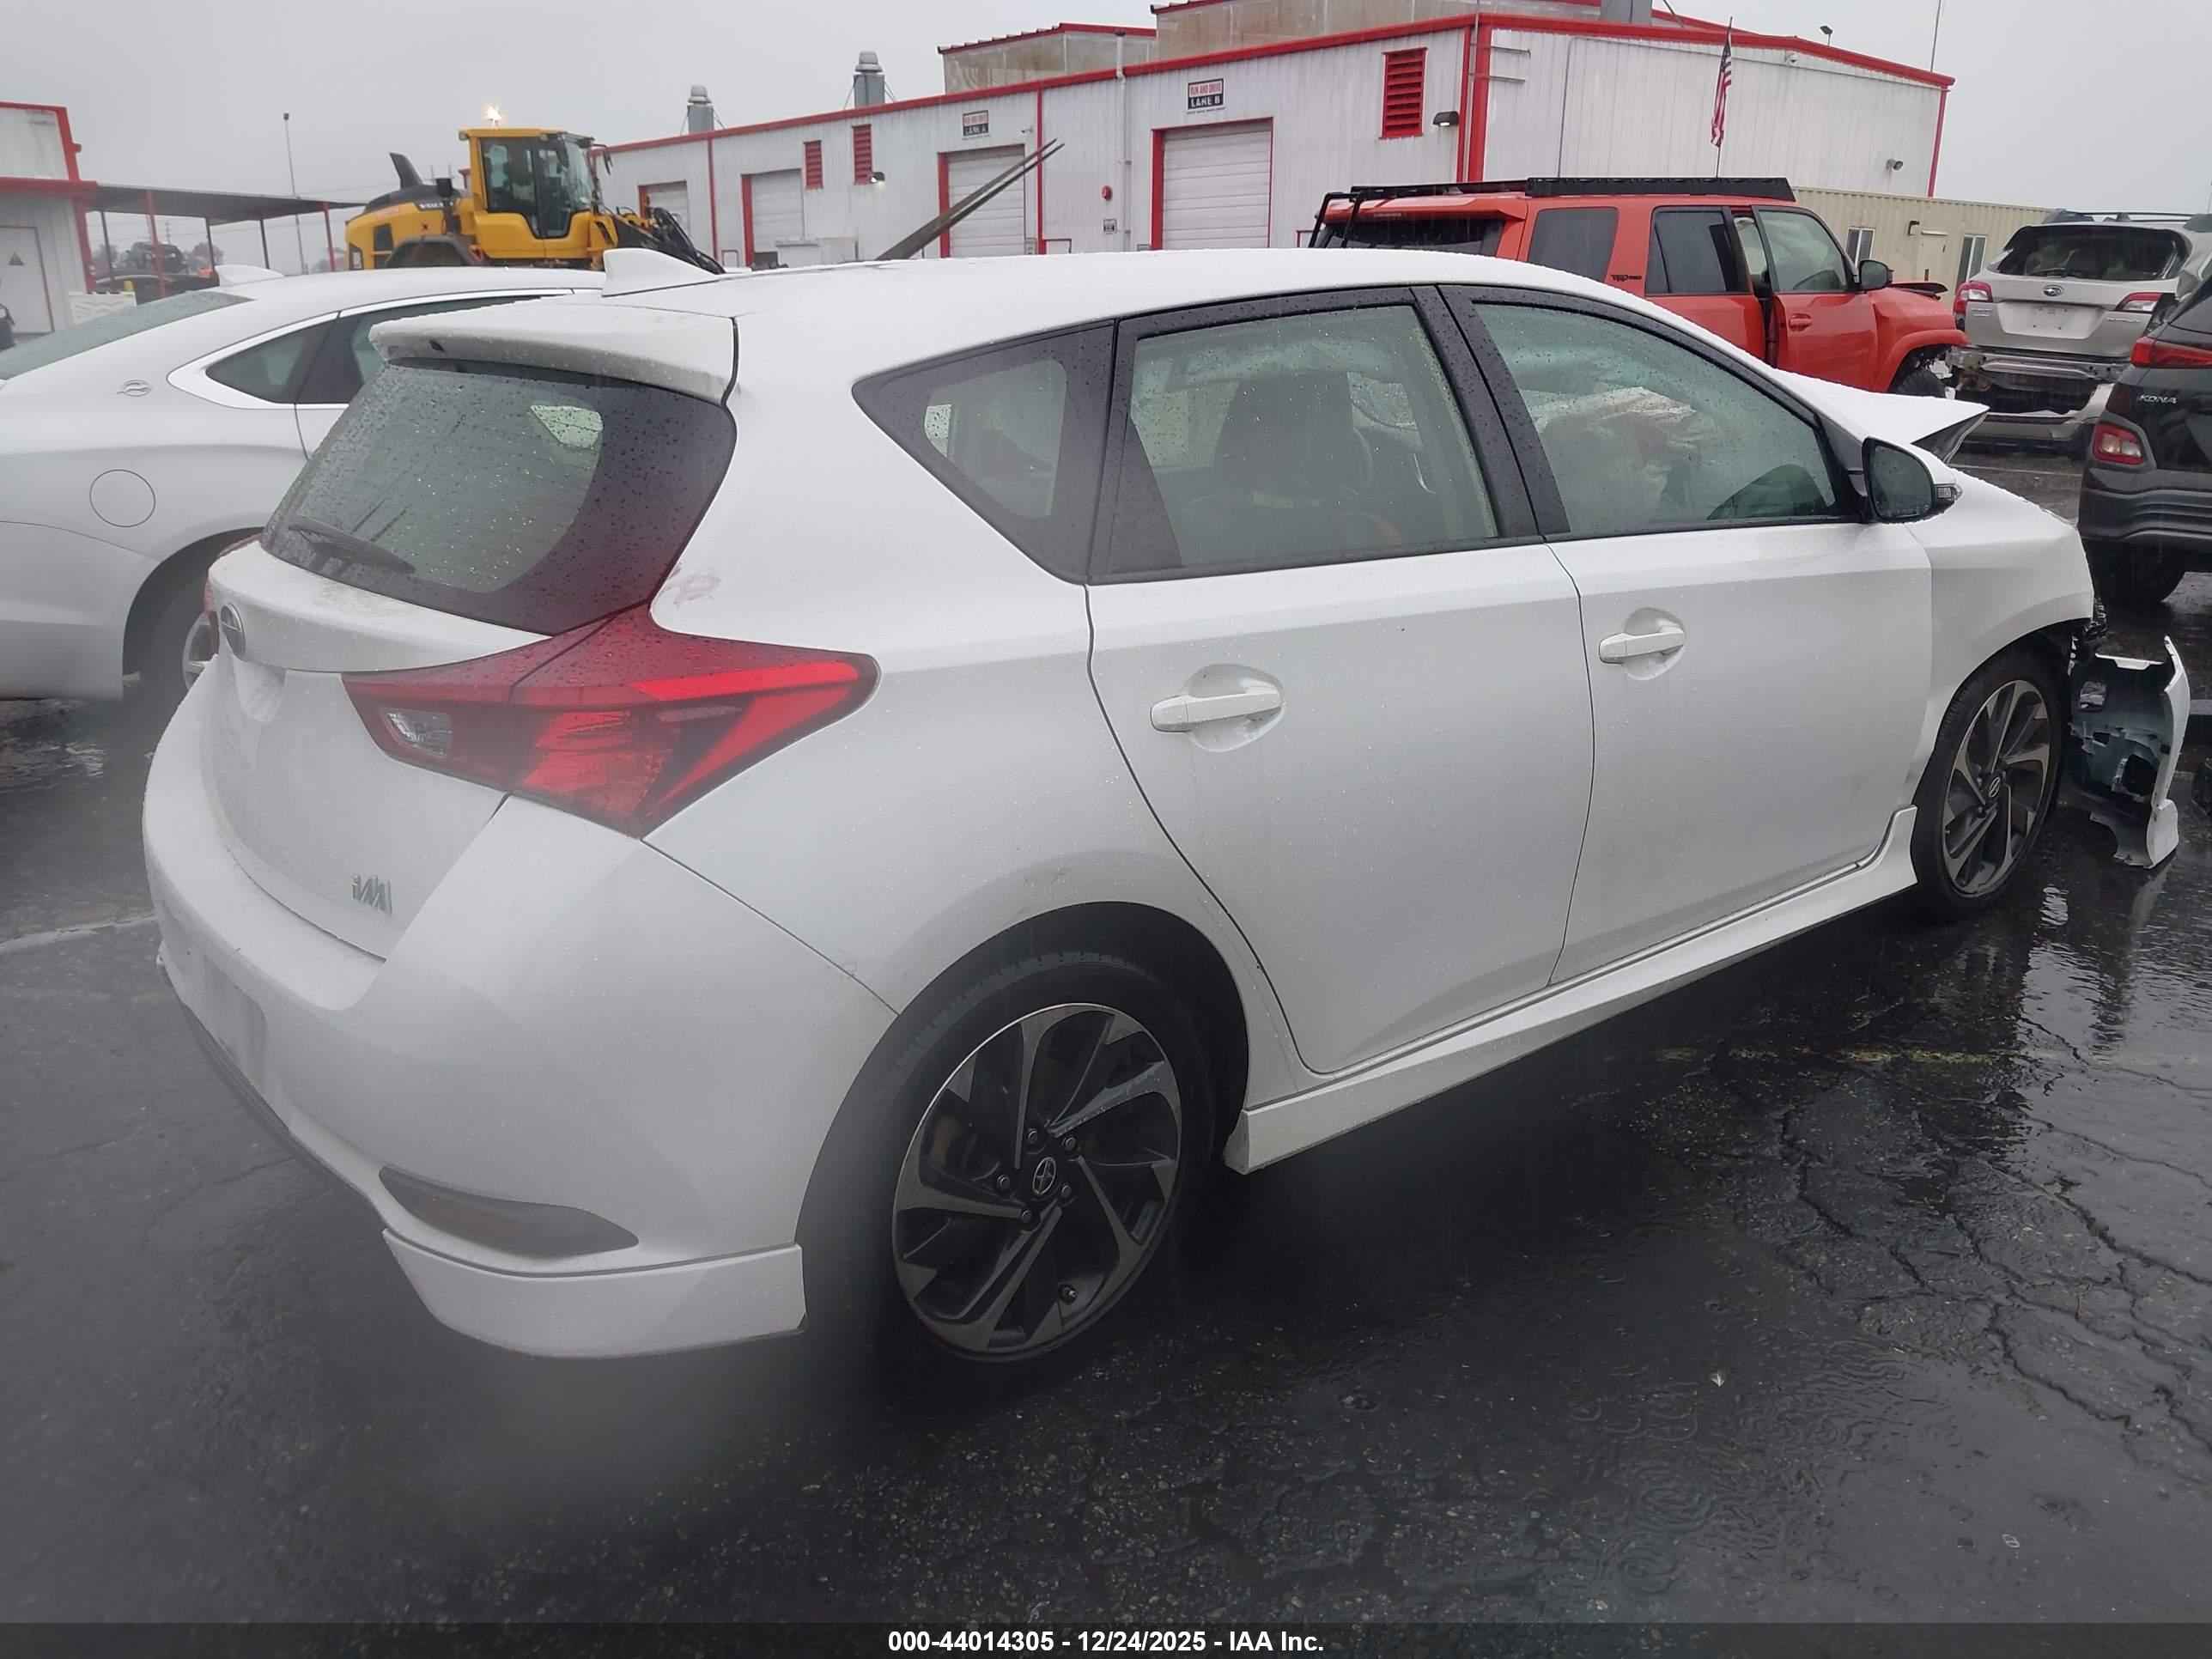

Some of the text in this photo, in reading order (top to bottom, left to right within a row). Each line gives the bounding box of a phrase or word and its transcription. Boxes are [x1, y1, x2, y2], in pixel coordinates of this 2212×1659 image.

[1191, 95, 1220, 107] LANE B
[2139, 395, 2177, 404] KONA
